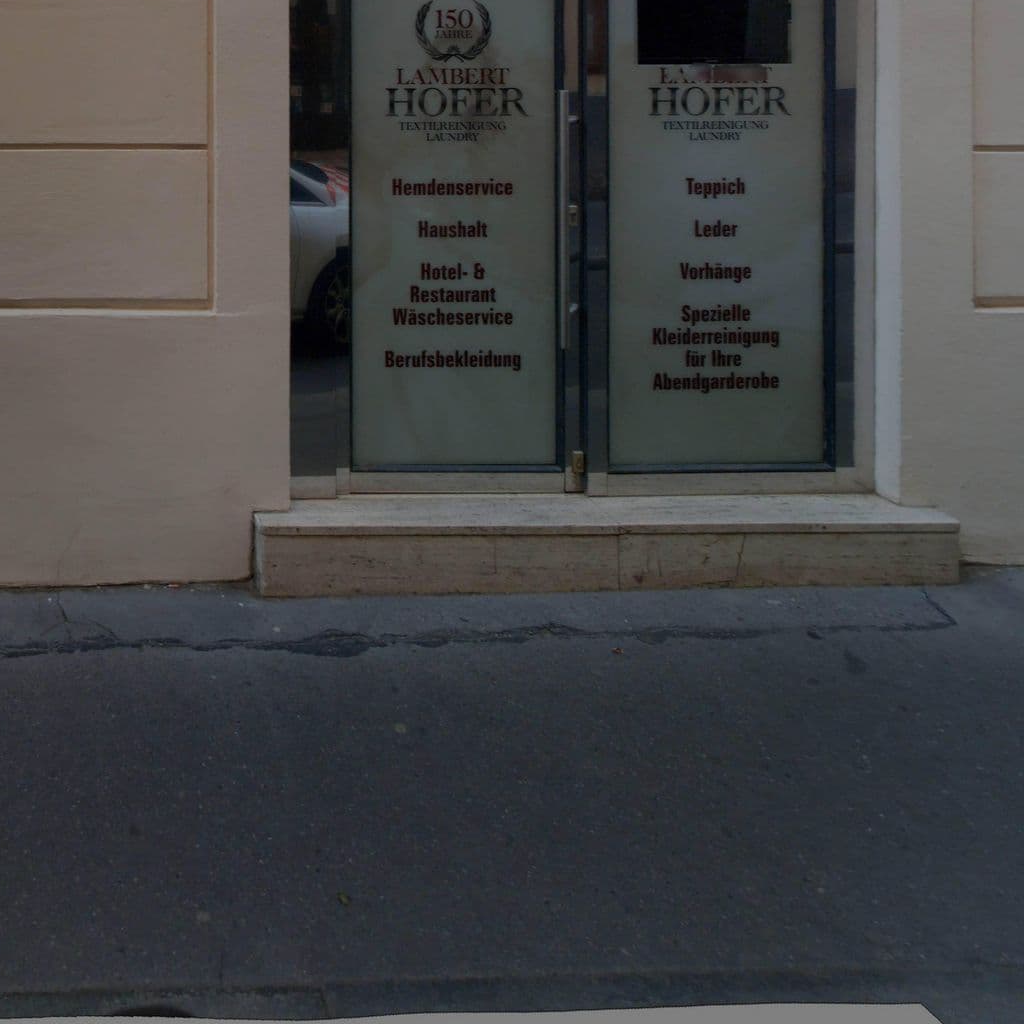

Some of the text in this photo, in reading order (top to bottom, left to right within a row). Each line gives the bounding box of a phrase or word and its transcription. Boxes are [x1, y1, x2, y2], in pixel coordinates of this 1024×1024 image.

[435, 9, 474, 29] 150
[434, 30, 473, 39] JAHRE
[395, 68, 511, 85] LAMBERT
[385, 87, 529, 117] HOFER
[647, 86, 793, 117] HOFER
[399, 121, 507, 131] TEXTILREINIGUNG
[662, 120, 770, 130] TEXTILREINIGUNG
[426, 132, 480, 142] LAUNDRY
[689, 131, 742, 141] LAUNDRY
[392, 179, 513, 196] Hemdenservice
[685, 177, 746, 199] Teppich
[418, 221, 488, 238] Haushalt
[694, 219, 738, 237] Leder
[420, 263, 486, 280] Hotel- &
[680, 262, 752, 283] Vorhänge
[410, 286, 496, 303] Restaurant
[392, 308, 513, 325] Wäscheservice
[681, 304, 751, 326] Spezielle
[652, 328, 780, 348] Kleiderreinigung
[384, 350, 522, 371] Berufsbekleidung
[685, 350, 742, 367] für Ihre
[652, 373, 780, 394] Abendgarderobe
